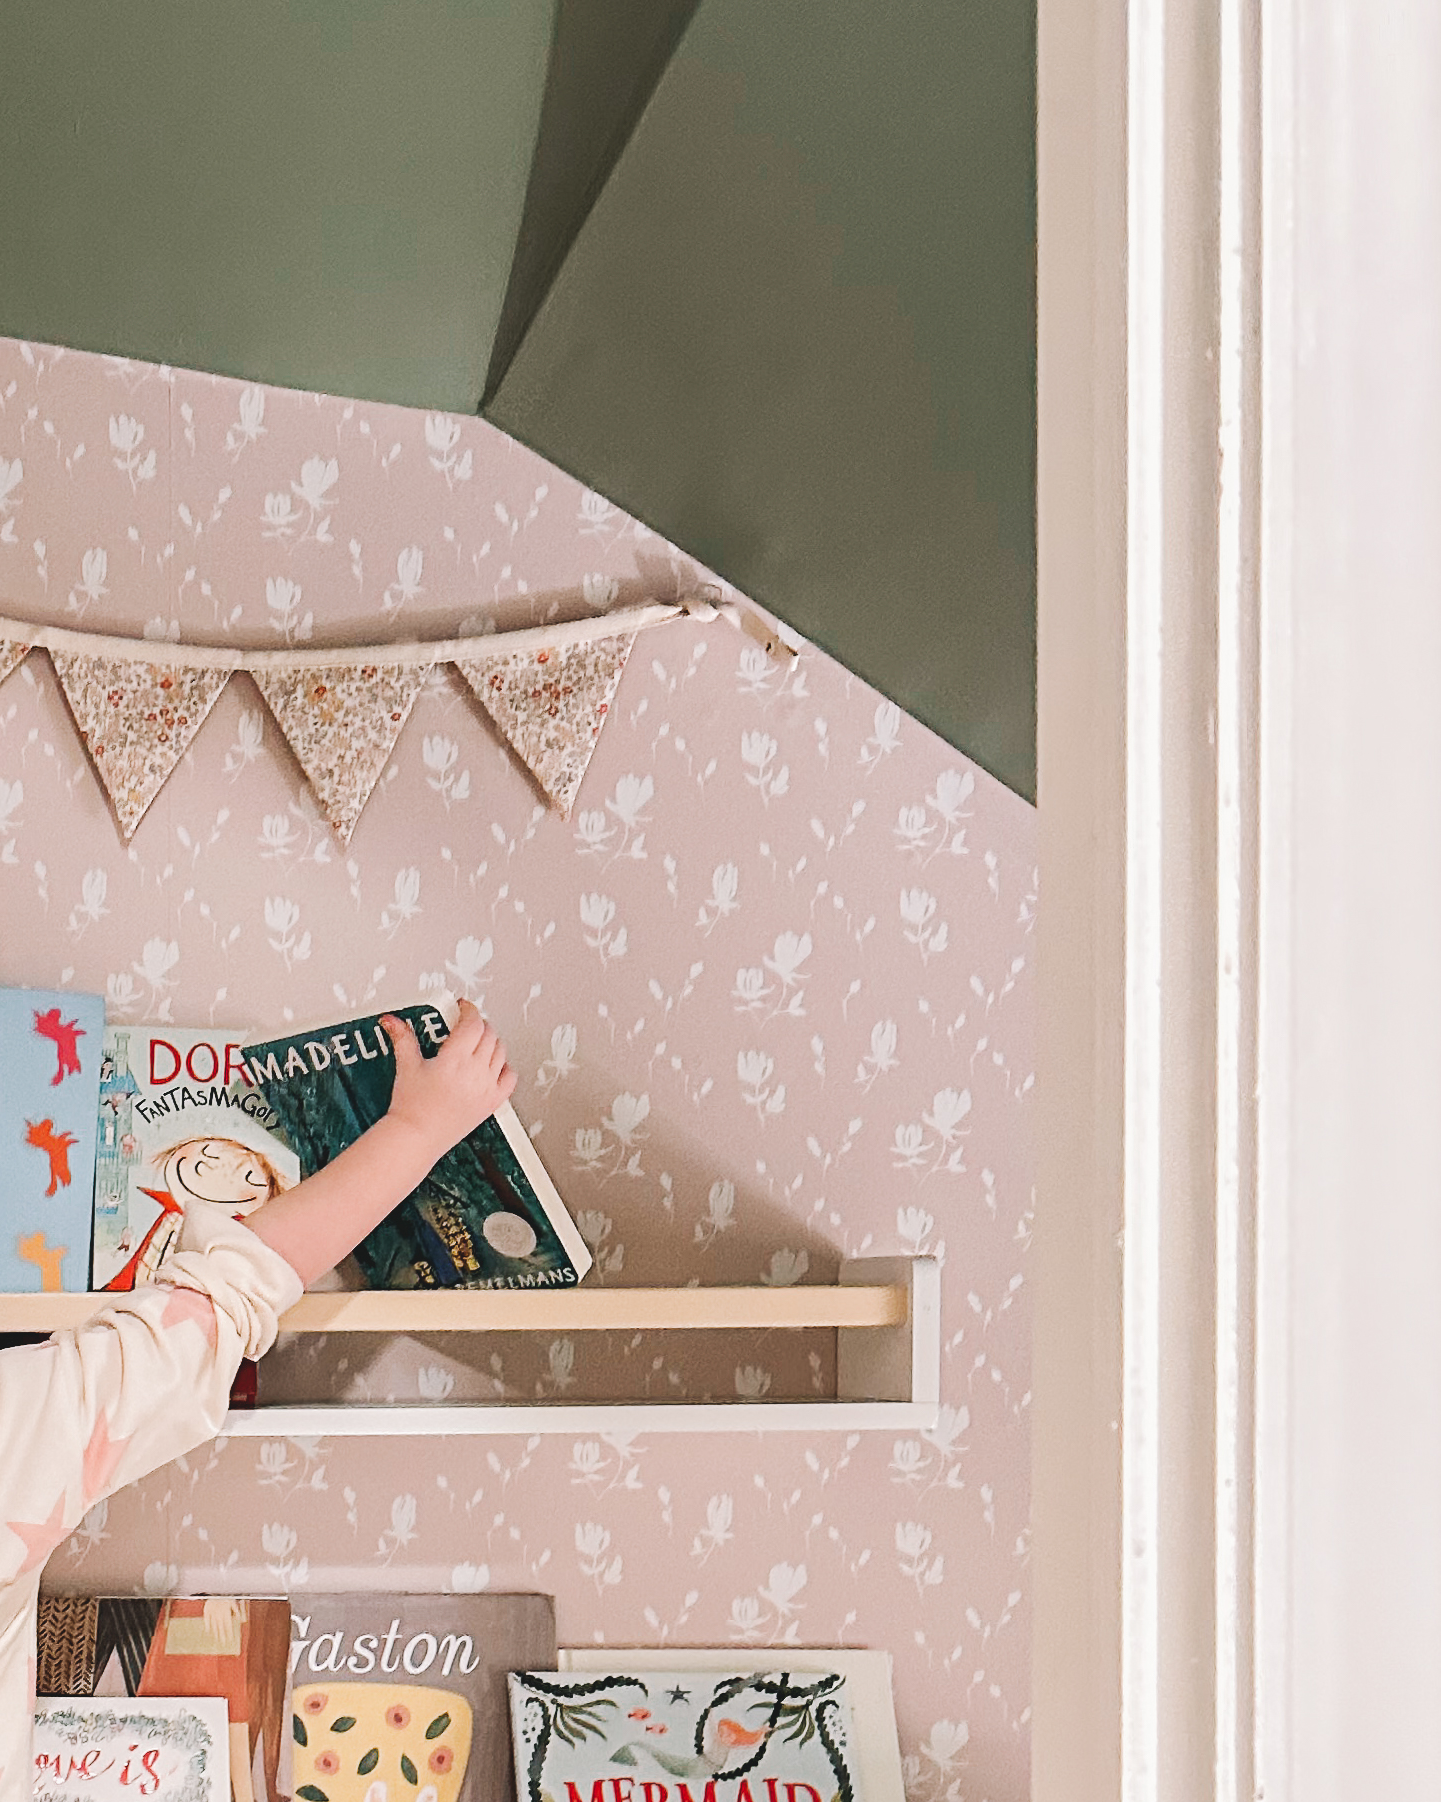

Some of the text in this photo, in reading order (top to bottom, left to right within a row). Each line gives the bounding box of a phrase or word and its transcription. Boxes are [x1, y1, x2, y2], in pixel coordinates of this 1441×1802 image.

[149, 1039, 255, 1088] DOR
[250, 1012, 449, 1084] MADELIE
[119, 1743, 161, 1795] is
